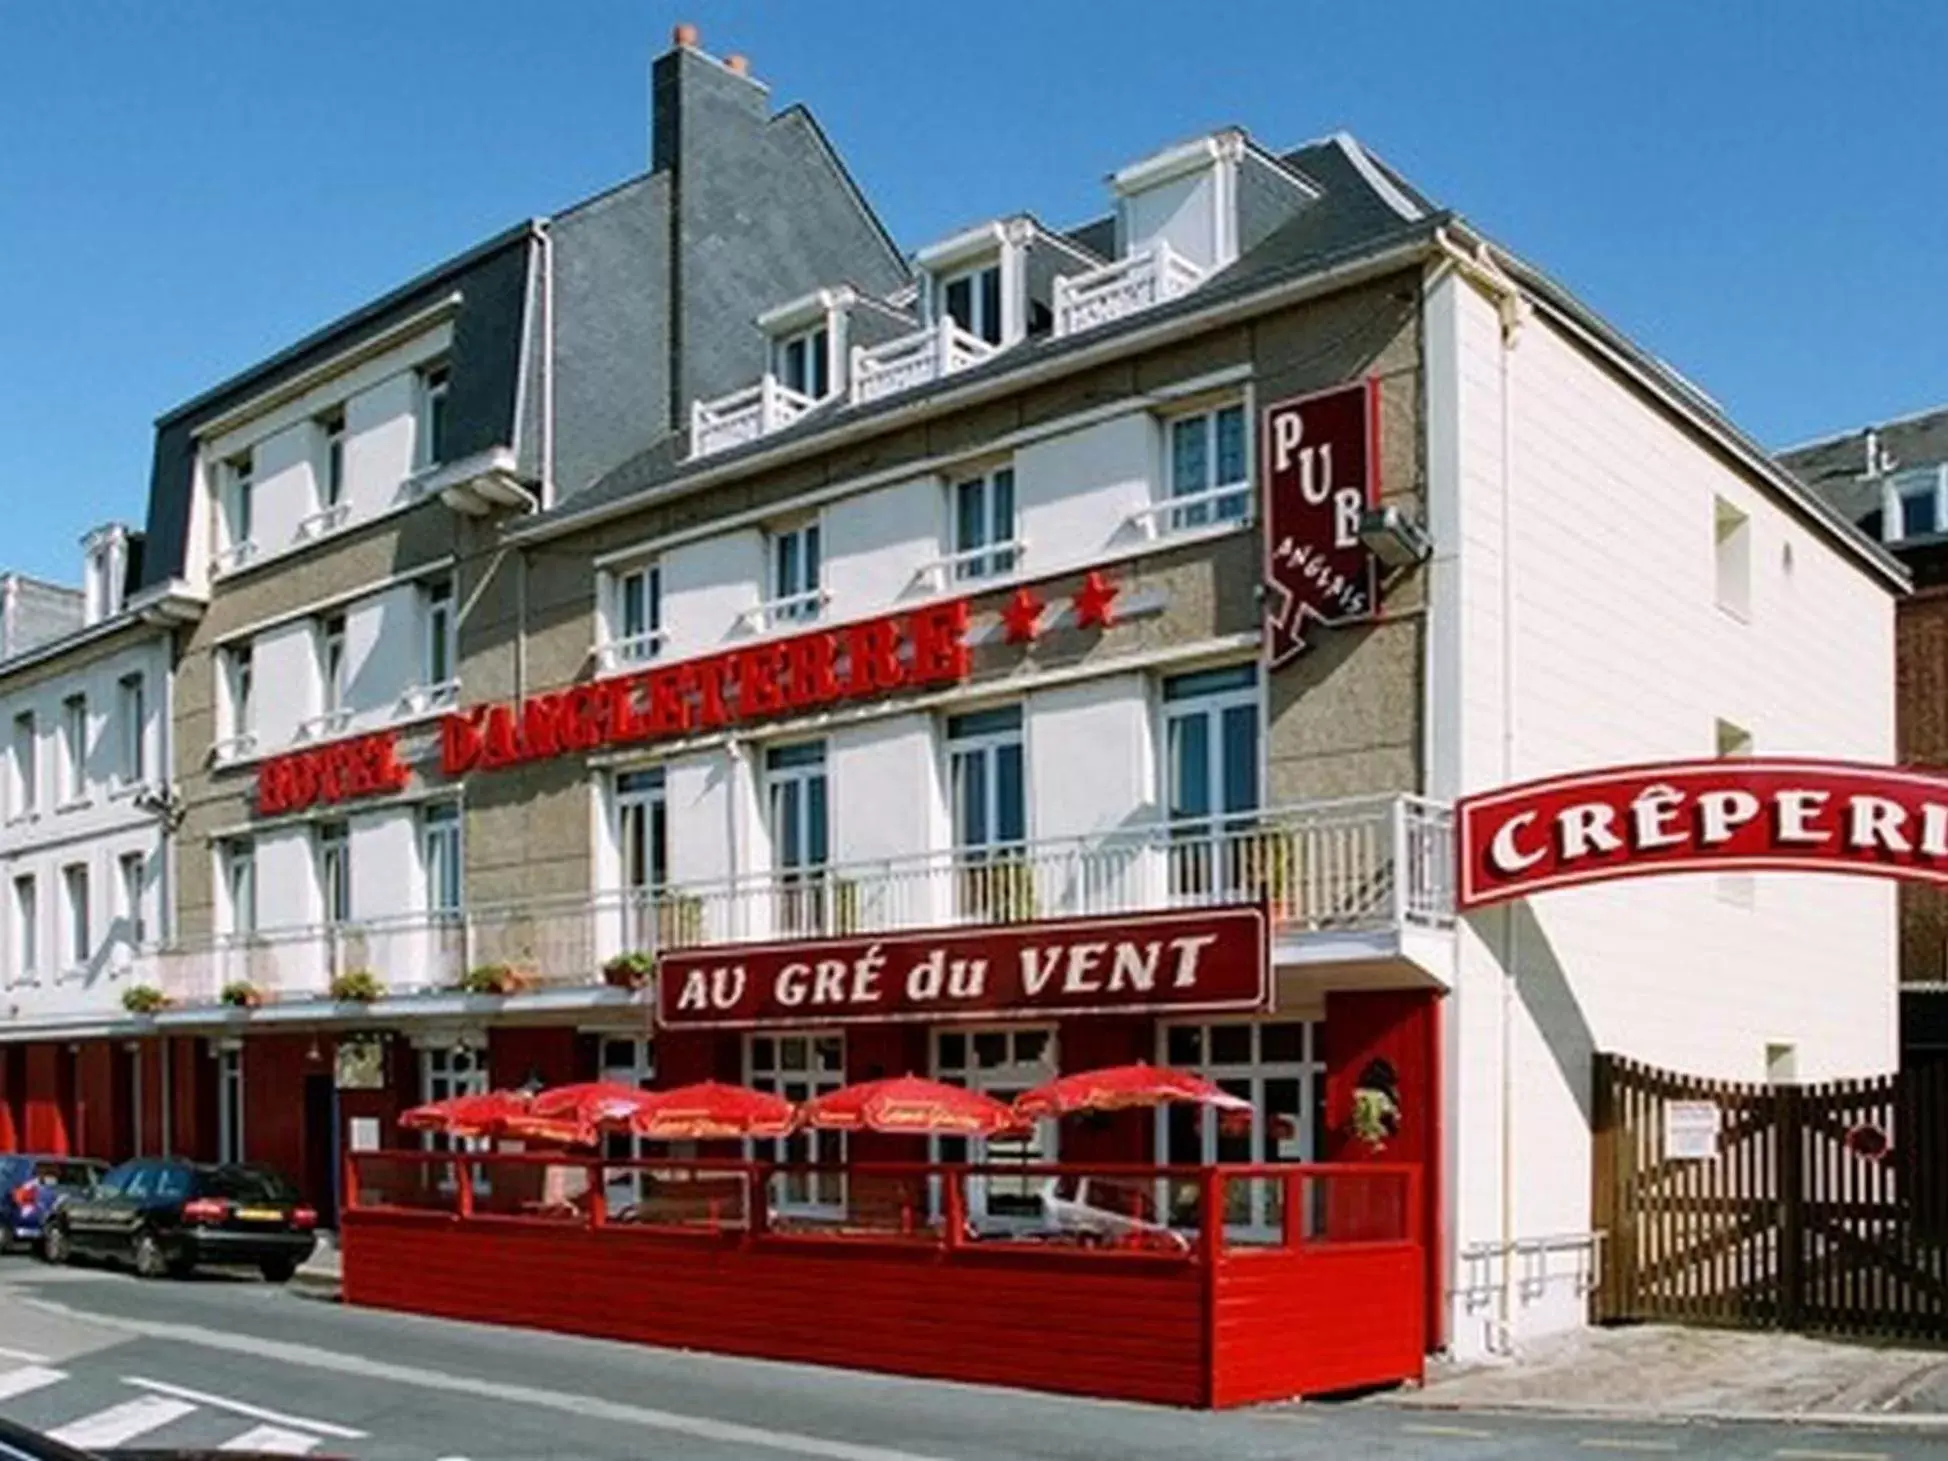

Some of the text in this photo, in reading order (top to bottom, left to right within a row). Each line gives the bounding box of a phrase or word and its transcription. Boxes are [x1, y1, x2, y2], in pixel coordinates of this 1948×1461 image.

[1273, 411, 1362, 549] PUB
[676, 934, 1218, 1010] AU GRÉ du VENT
